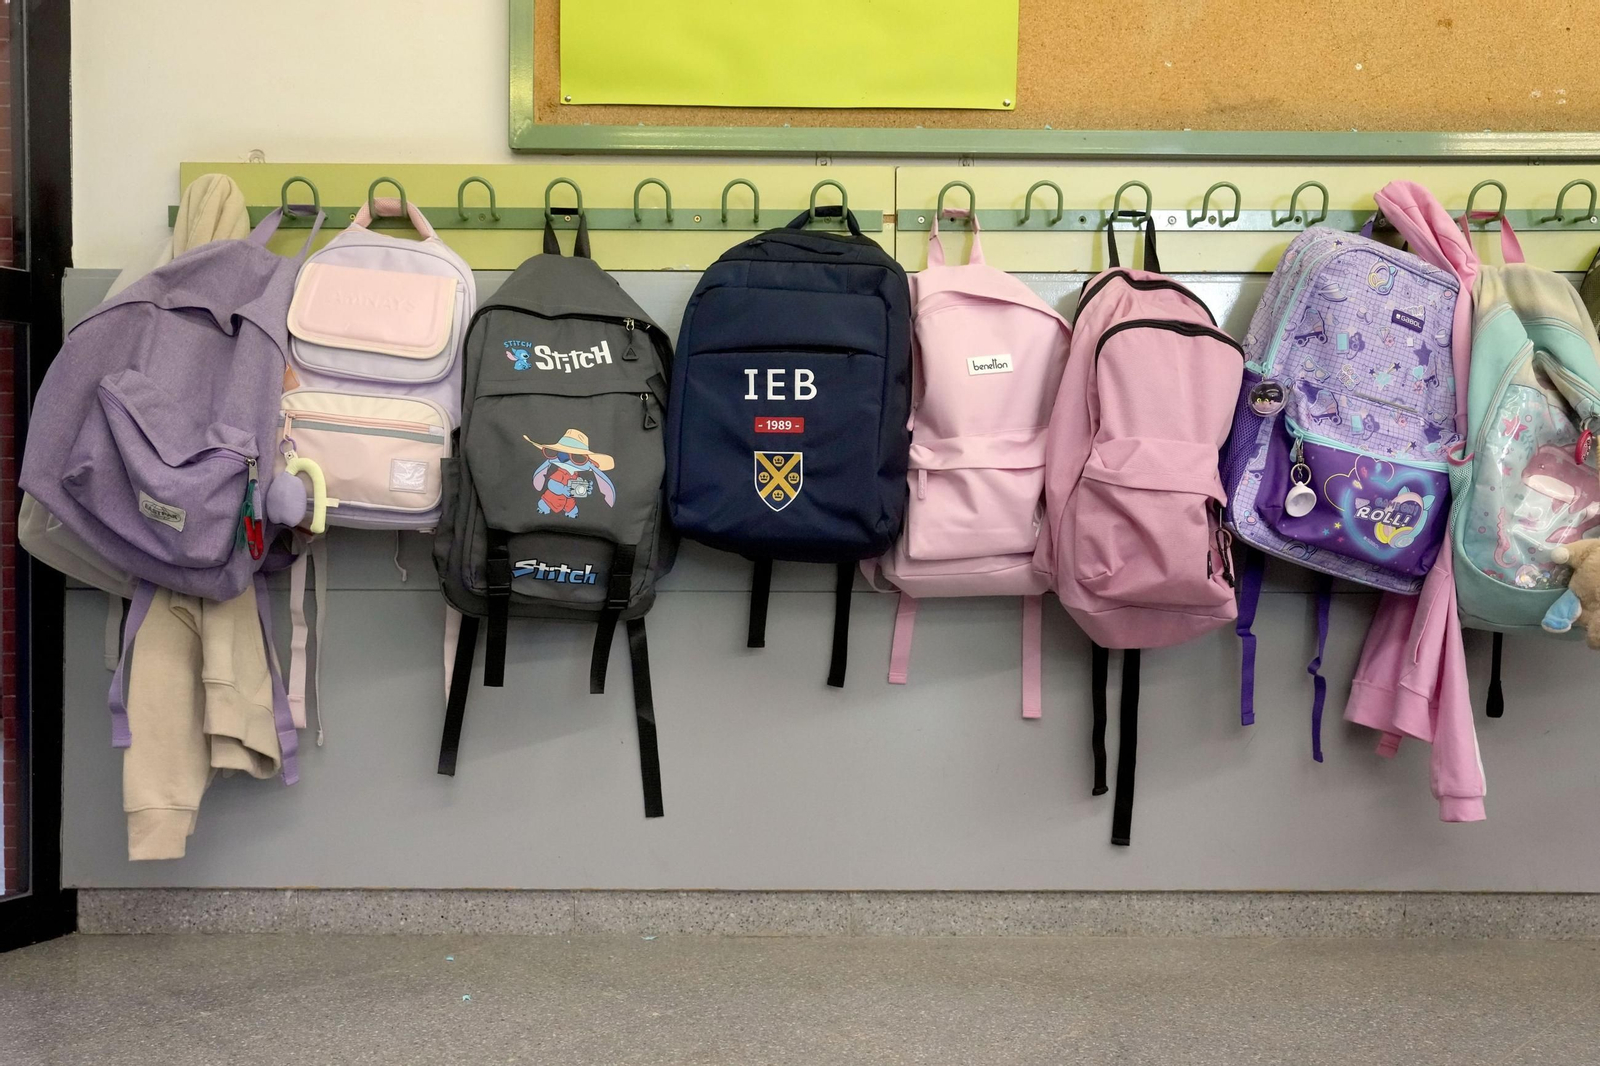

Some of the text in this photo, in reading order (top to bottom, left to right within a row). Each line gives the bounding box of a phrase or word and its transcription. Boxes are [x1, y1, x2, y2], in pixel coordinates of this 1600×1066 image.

[972, 358, 1009, 371] benetton
[744, 368, 818, 401] IEB
[766, 419, 792, 431] 1989
[1355, 505, 1411, 528] ROLL!
[511, 558, 598, 585] Stitch
